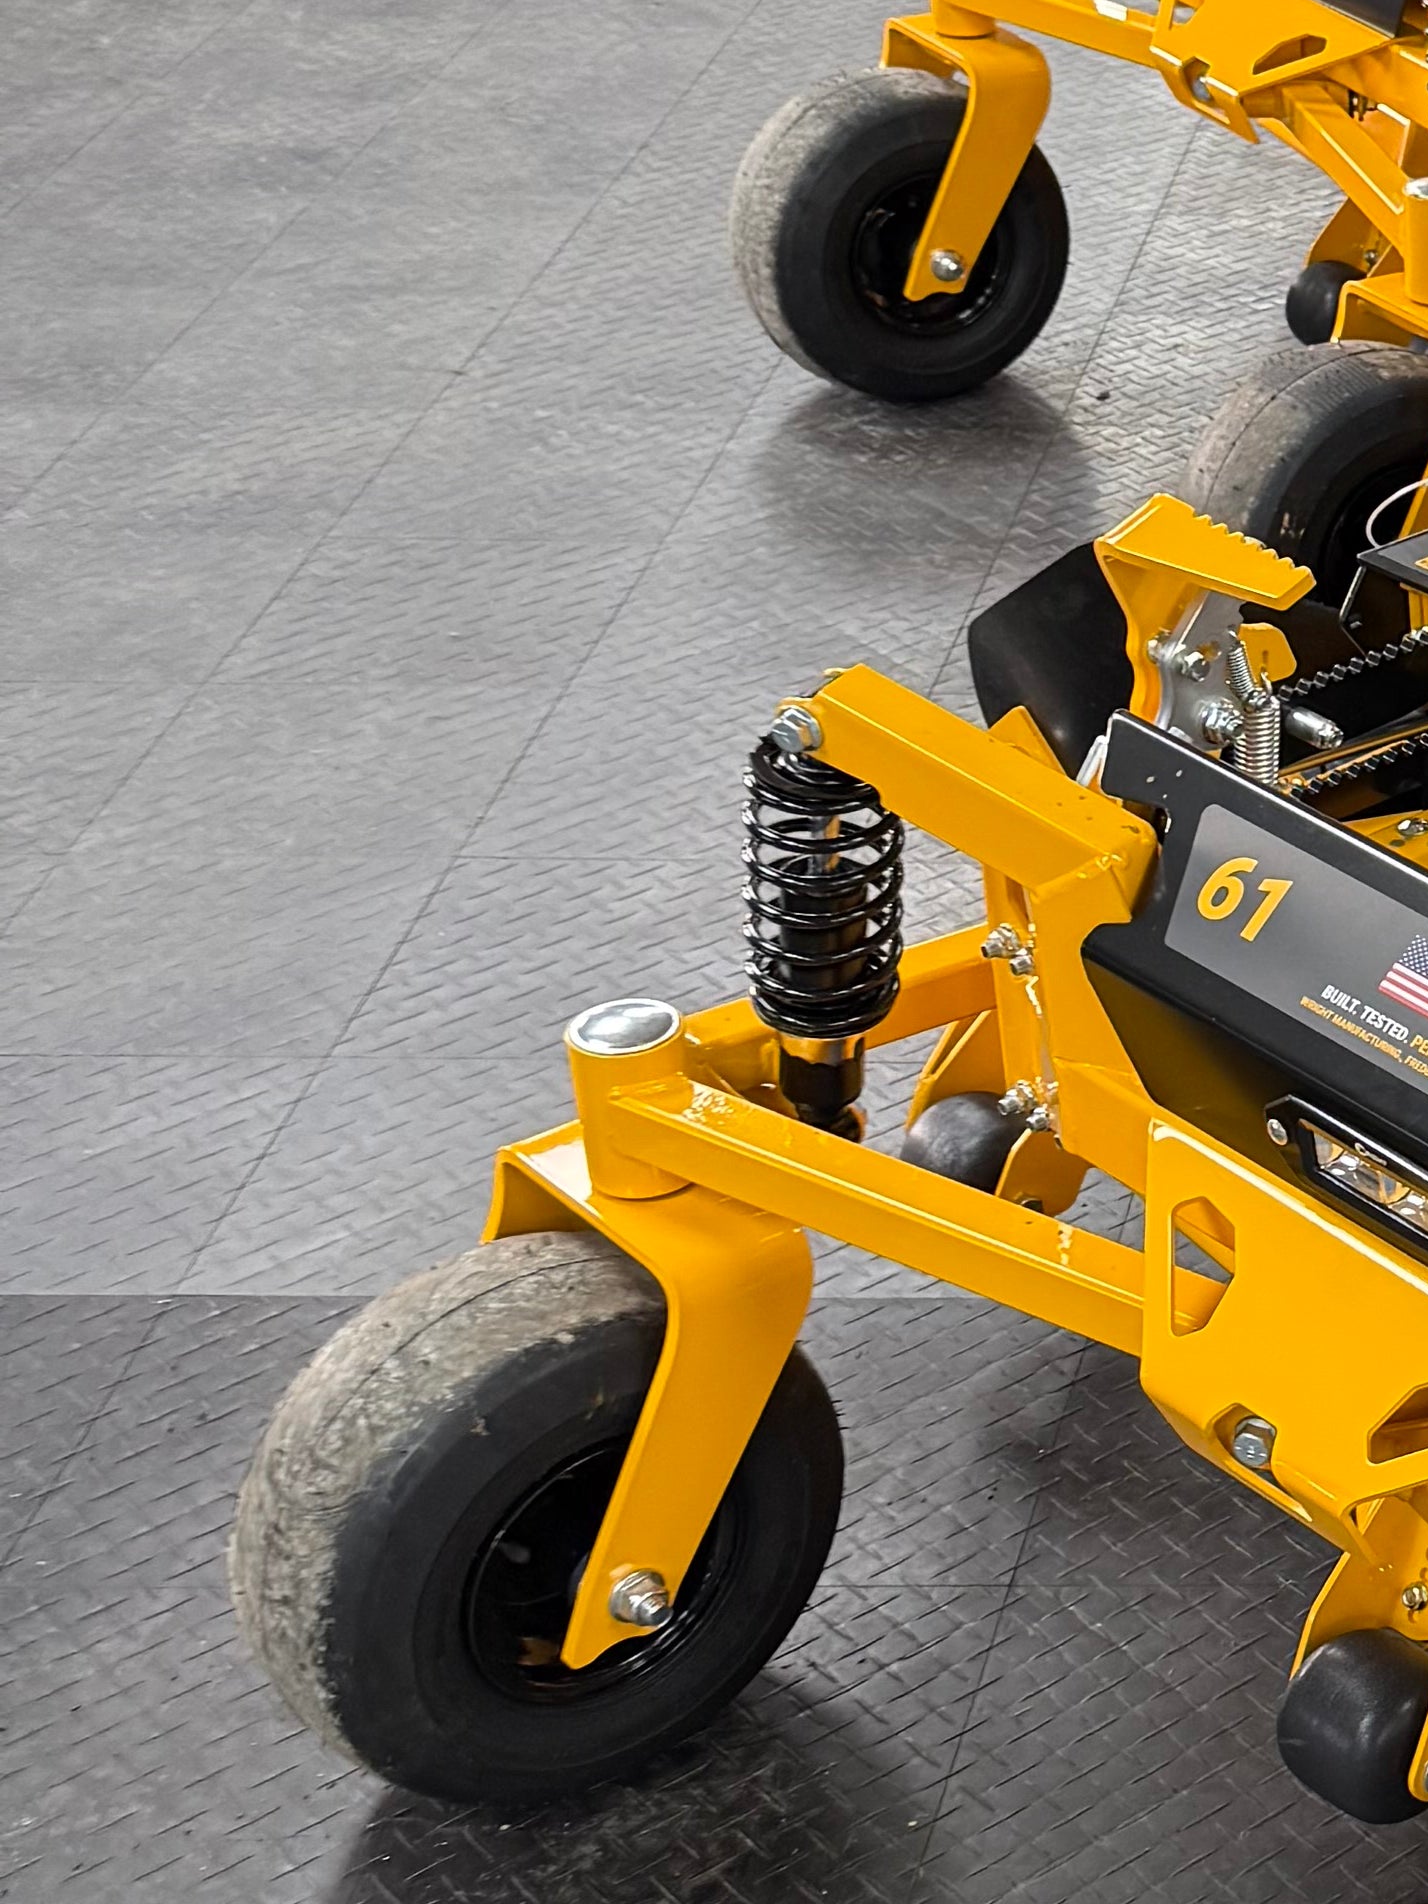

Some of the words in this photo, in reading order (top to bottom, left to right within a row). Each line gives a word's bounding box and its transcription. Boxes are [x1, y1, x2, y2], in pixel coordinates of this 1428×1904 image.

[1196, 855, 1294, 943] 61
[1300, 996, 1335, 1020] WRIGHT
[1320, 984, 1361, 1016] BUILT.
[1360, 1005, 1411, 1044] TESTED.
